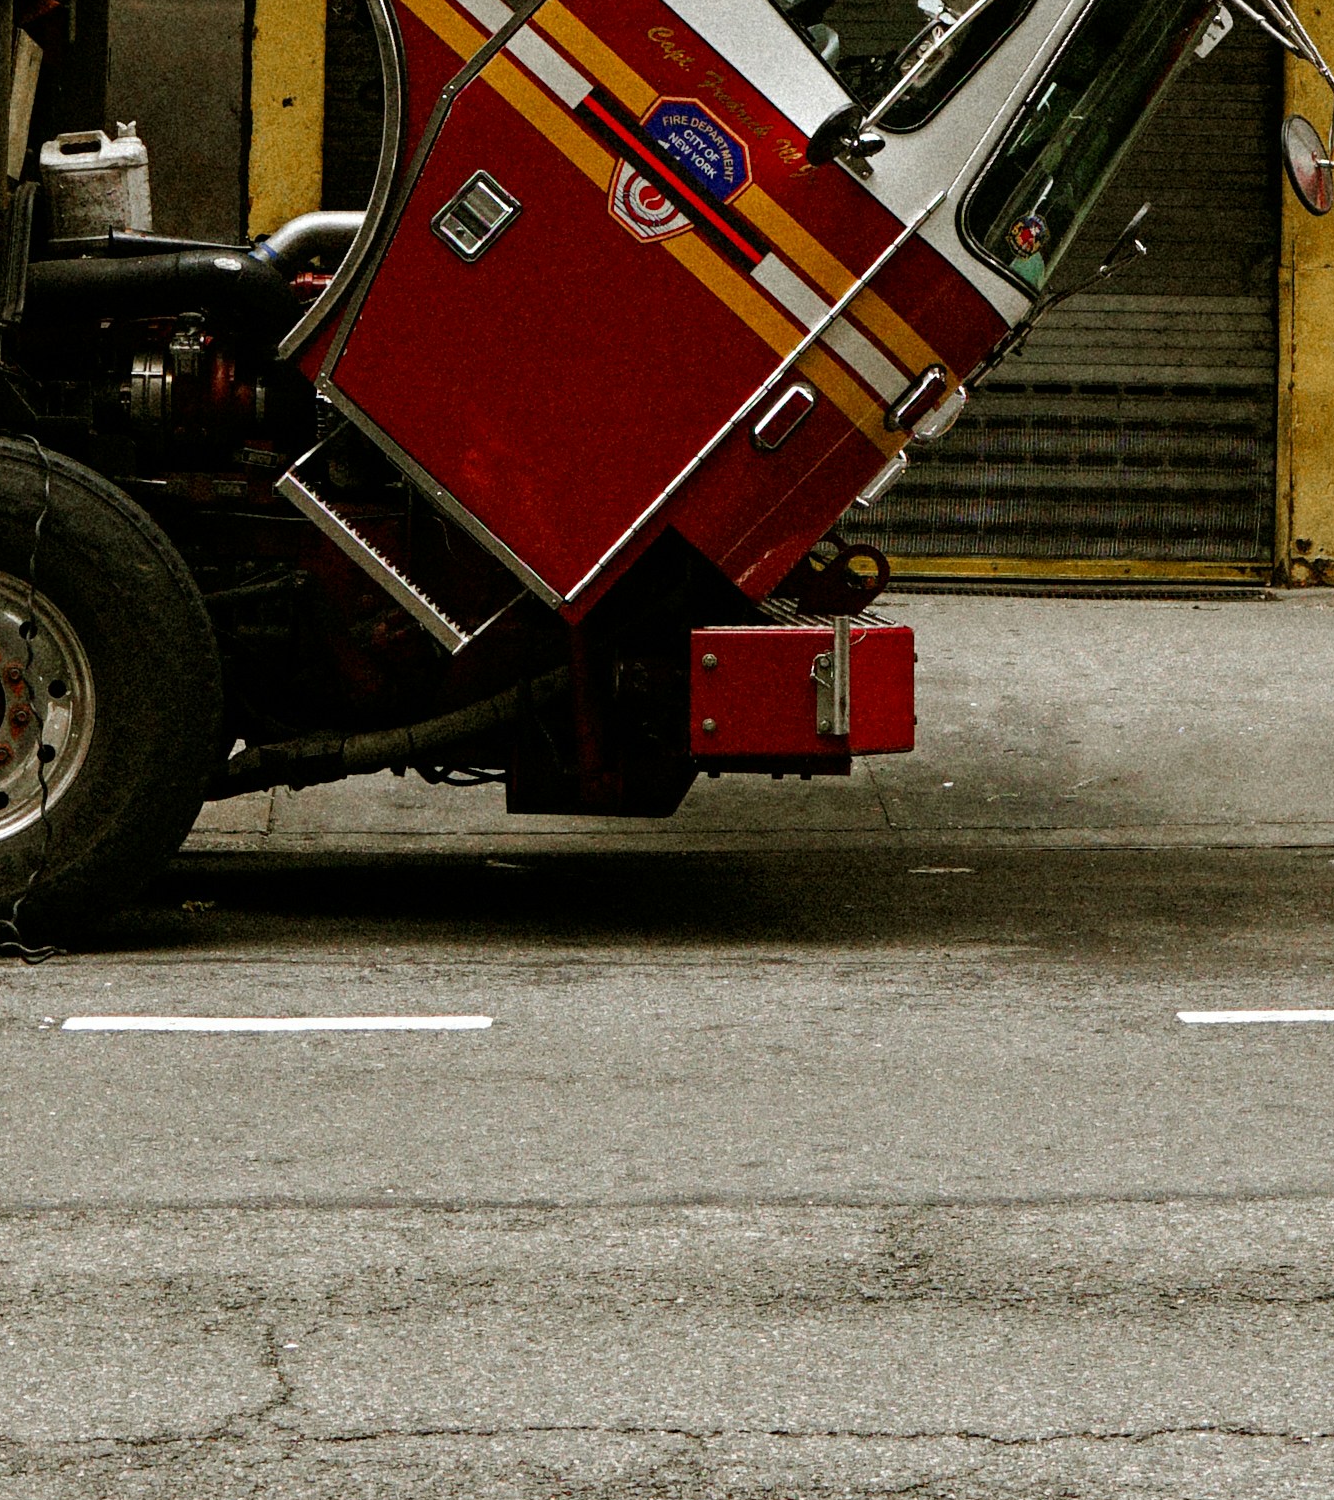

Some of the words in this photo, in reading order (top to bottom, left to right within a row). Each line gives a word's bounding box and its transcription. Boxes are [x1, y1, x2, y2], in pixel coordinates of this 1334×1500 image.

[663, 115, 689, 127] FIRE
[690, 117, 734, 184] DEPARTMENT
[668, 132, 693, 155] NEW
[690, 152, 718, 179] YORK
[683, 129, 707, 150] CITY
[704, 148, 720, 162] OF
